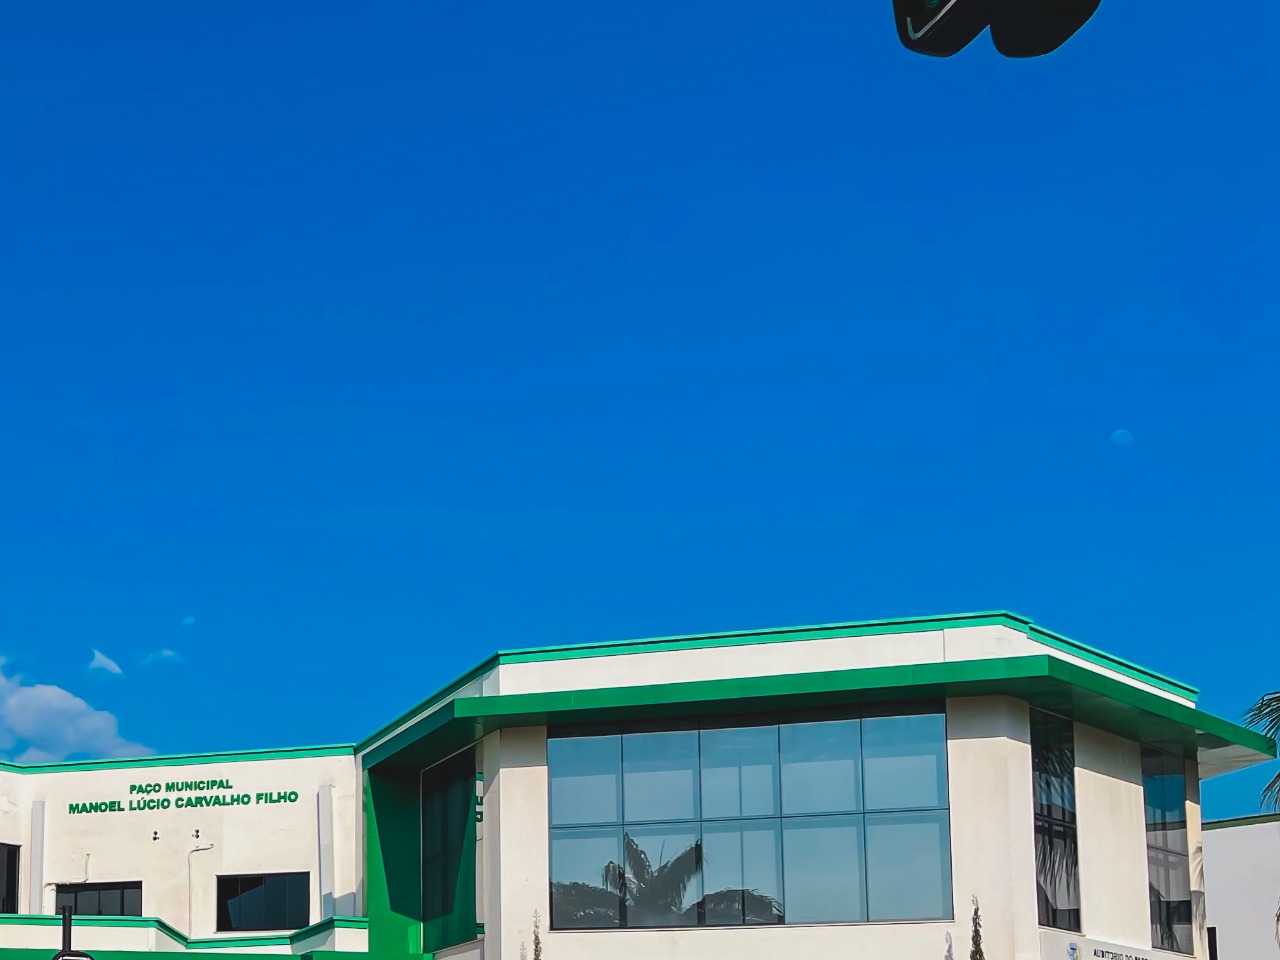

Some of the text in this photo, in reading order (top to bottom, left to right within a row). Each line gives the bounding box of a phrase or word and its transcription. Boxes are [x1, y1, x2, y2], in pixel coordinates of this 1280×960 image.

[129, 779, 233, 795] PAÇO MUNICIPAL
[68, 790, 299, 814] MANOEL LÚCIO CARVALHO FILHO
